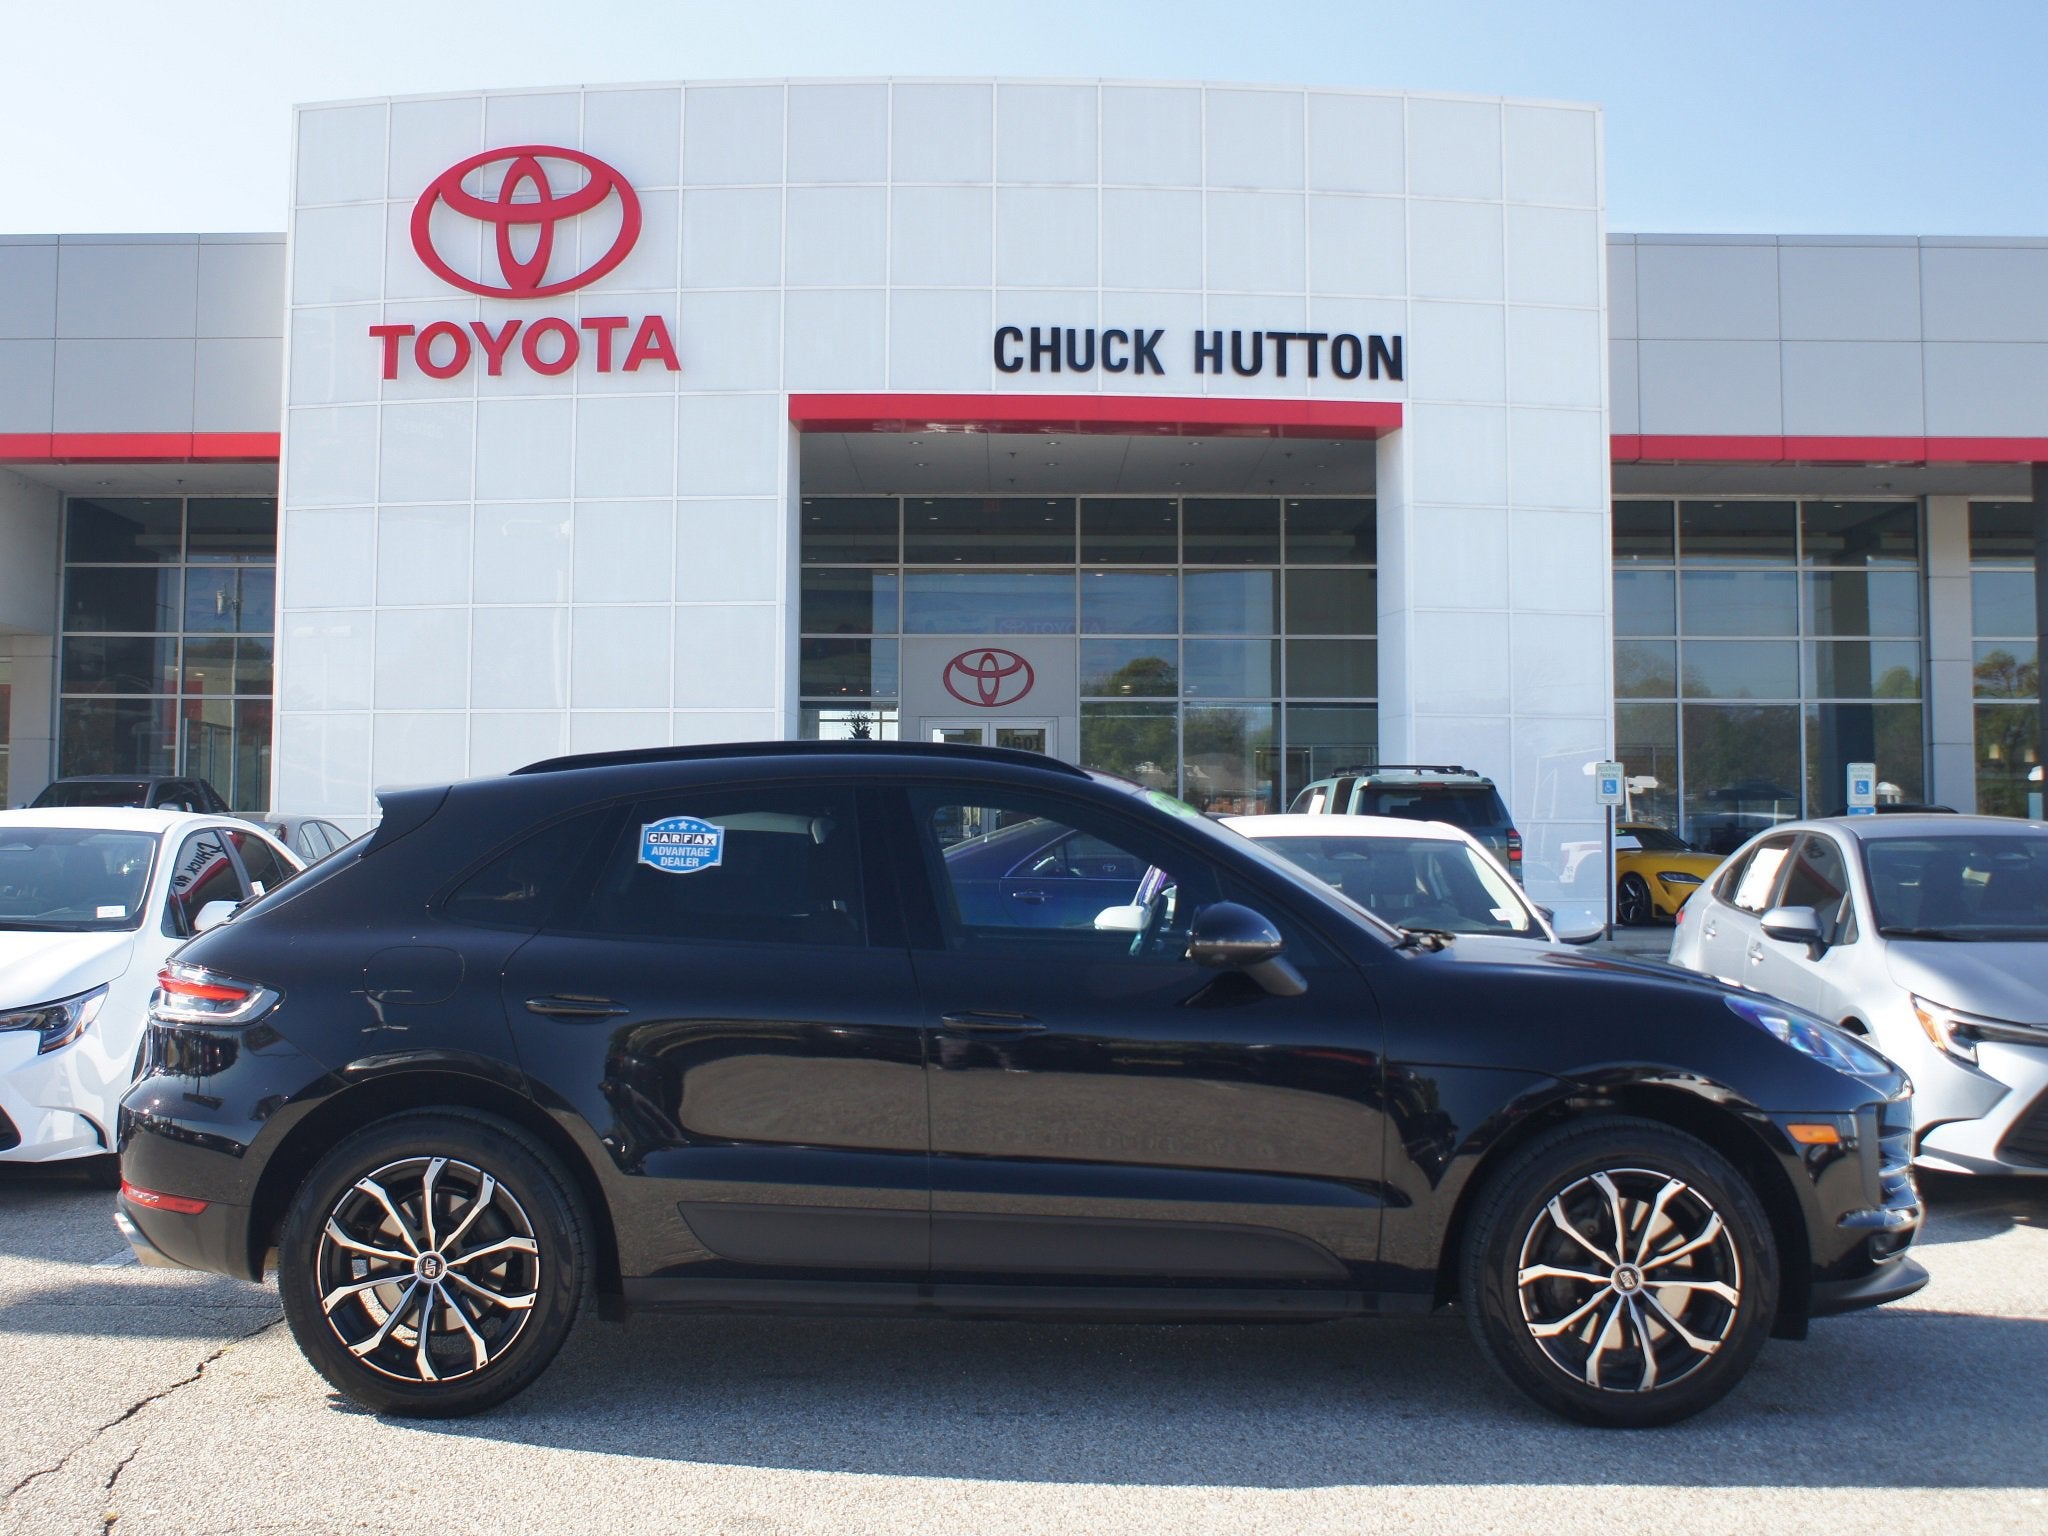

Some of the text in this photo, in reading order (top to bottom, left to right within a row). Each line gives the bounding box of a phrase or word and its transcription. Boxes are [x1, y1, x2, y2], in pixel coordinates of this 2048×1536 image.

[369, 315, 682, 380] TOYOTA
[993, 326, 1404, 381] CHUCK HUTTON
[648, 833, 716, 846] CARFAX
[651, 846, 711, 857] ADVANTAGE
[660, 857, 699, 867] DEALER
